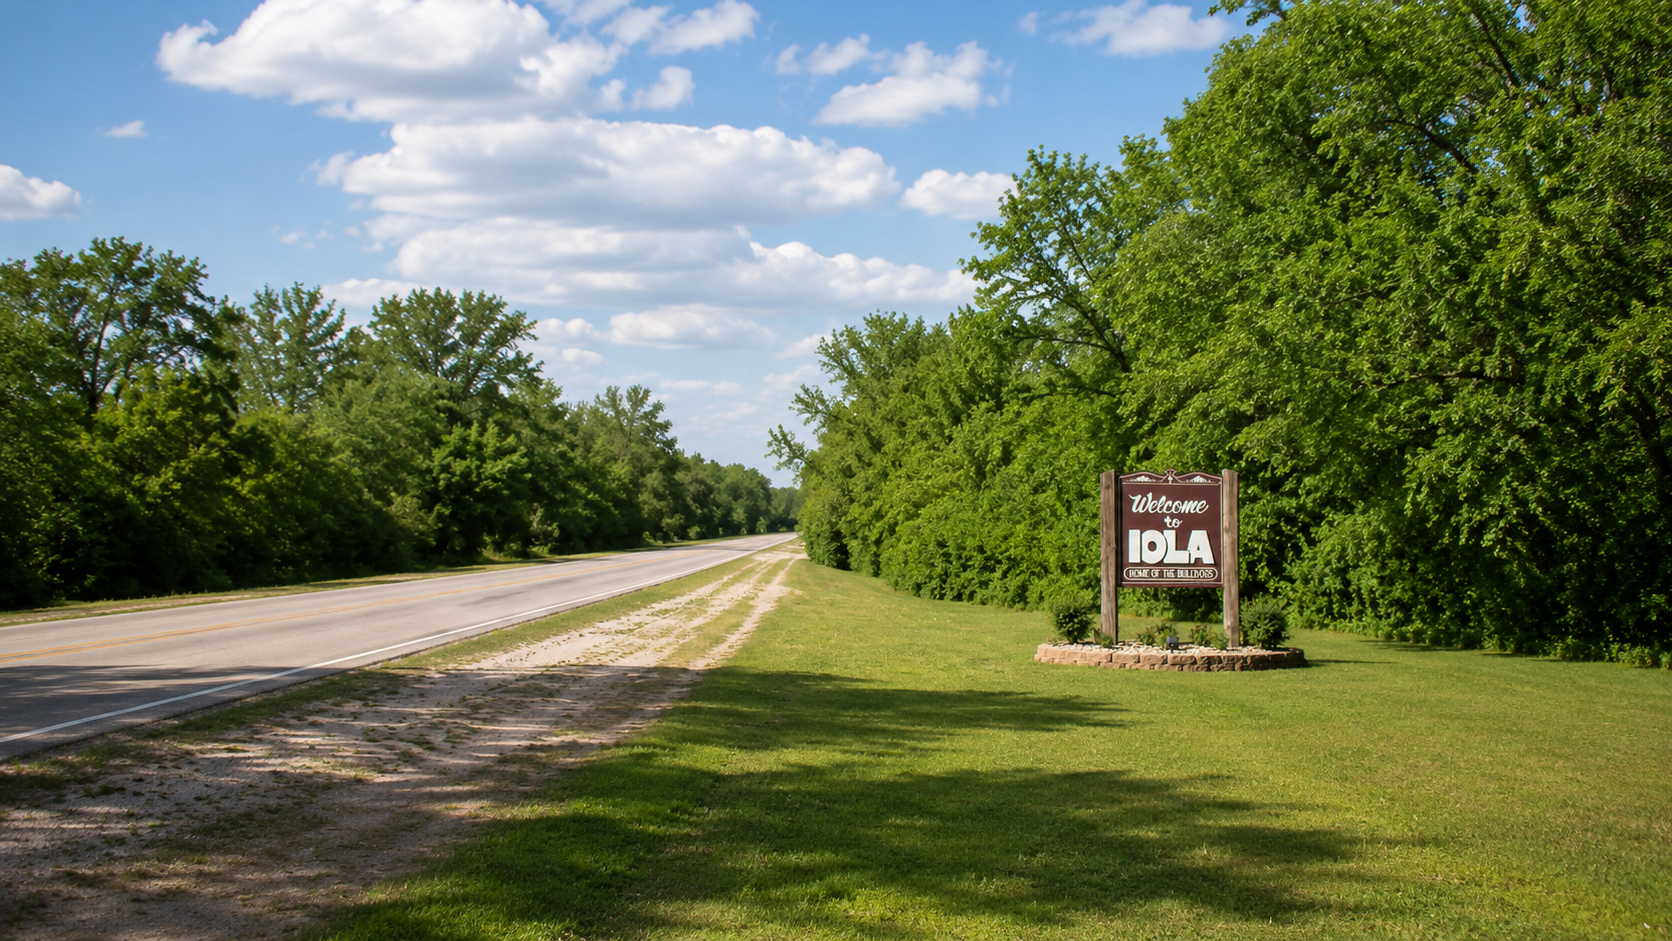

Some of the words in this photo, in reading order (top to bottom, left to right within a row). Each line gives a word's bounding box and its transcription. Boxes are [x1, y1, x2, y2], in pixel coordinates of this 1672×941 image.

[1128, 492, 1209, 513] Welcome
[1163, 515, 1183, 528] to
[1128, 529, 1215, 564] IOLA
